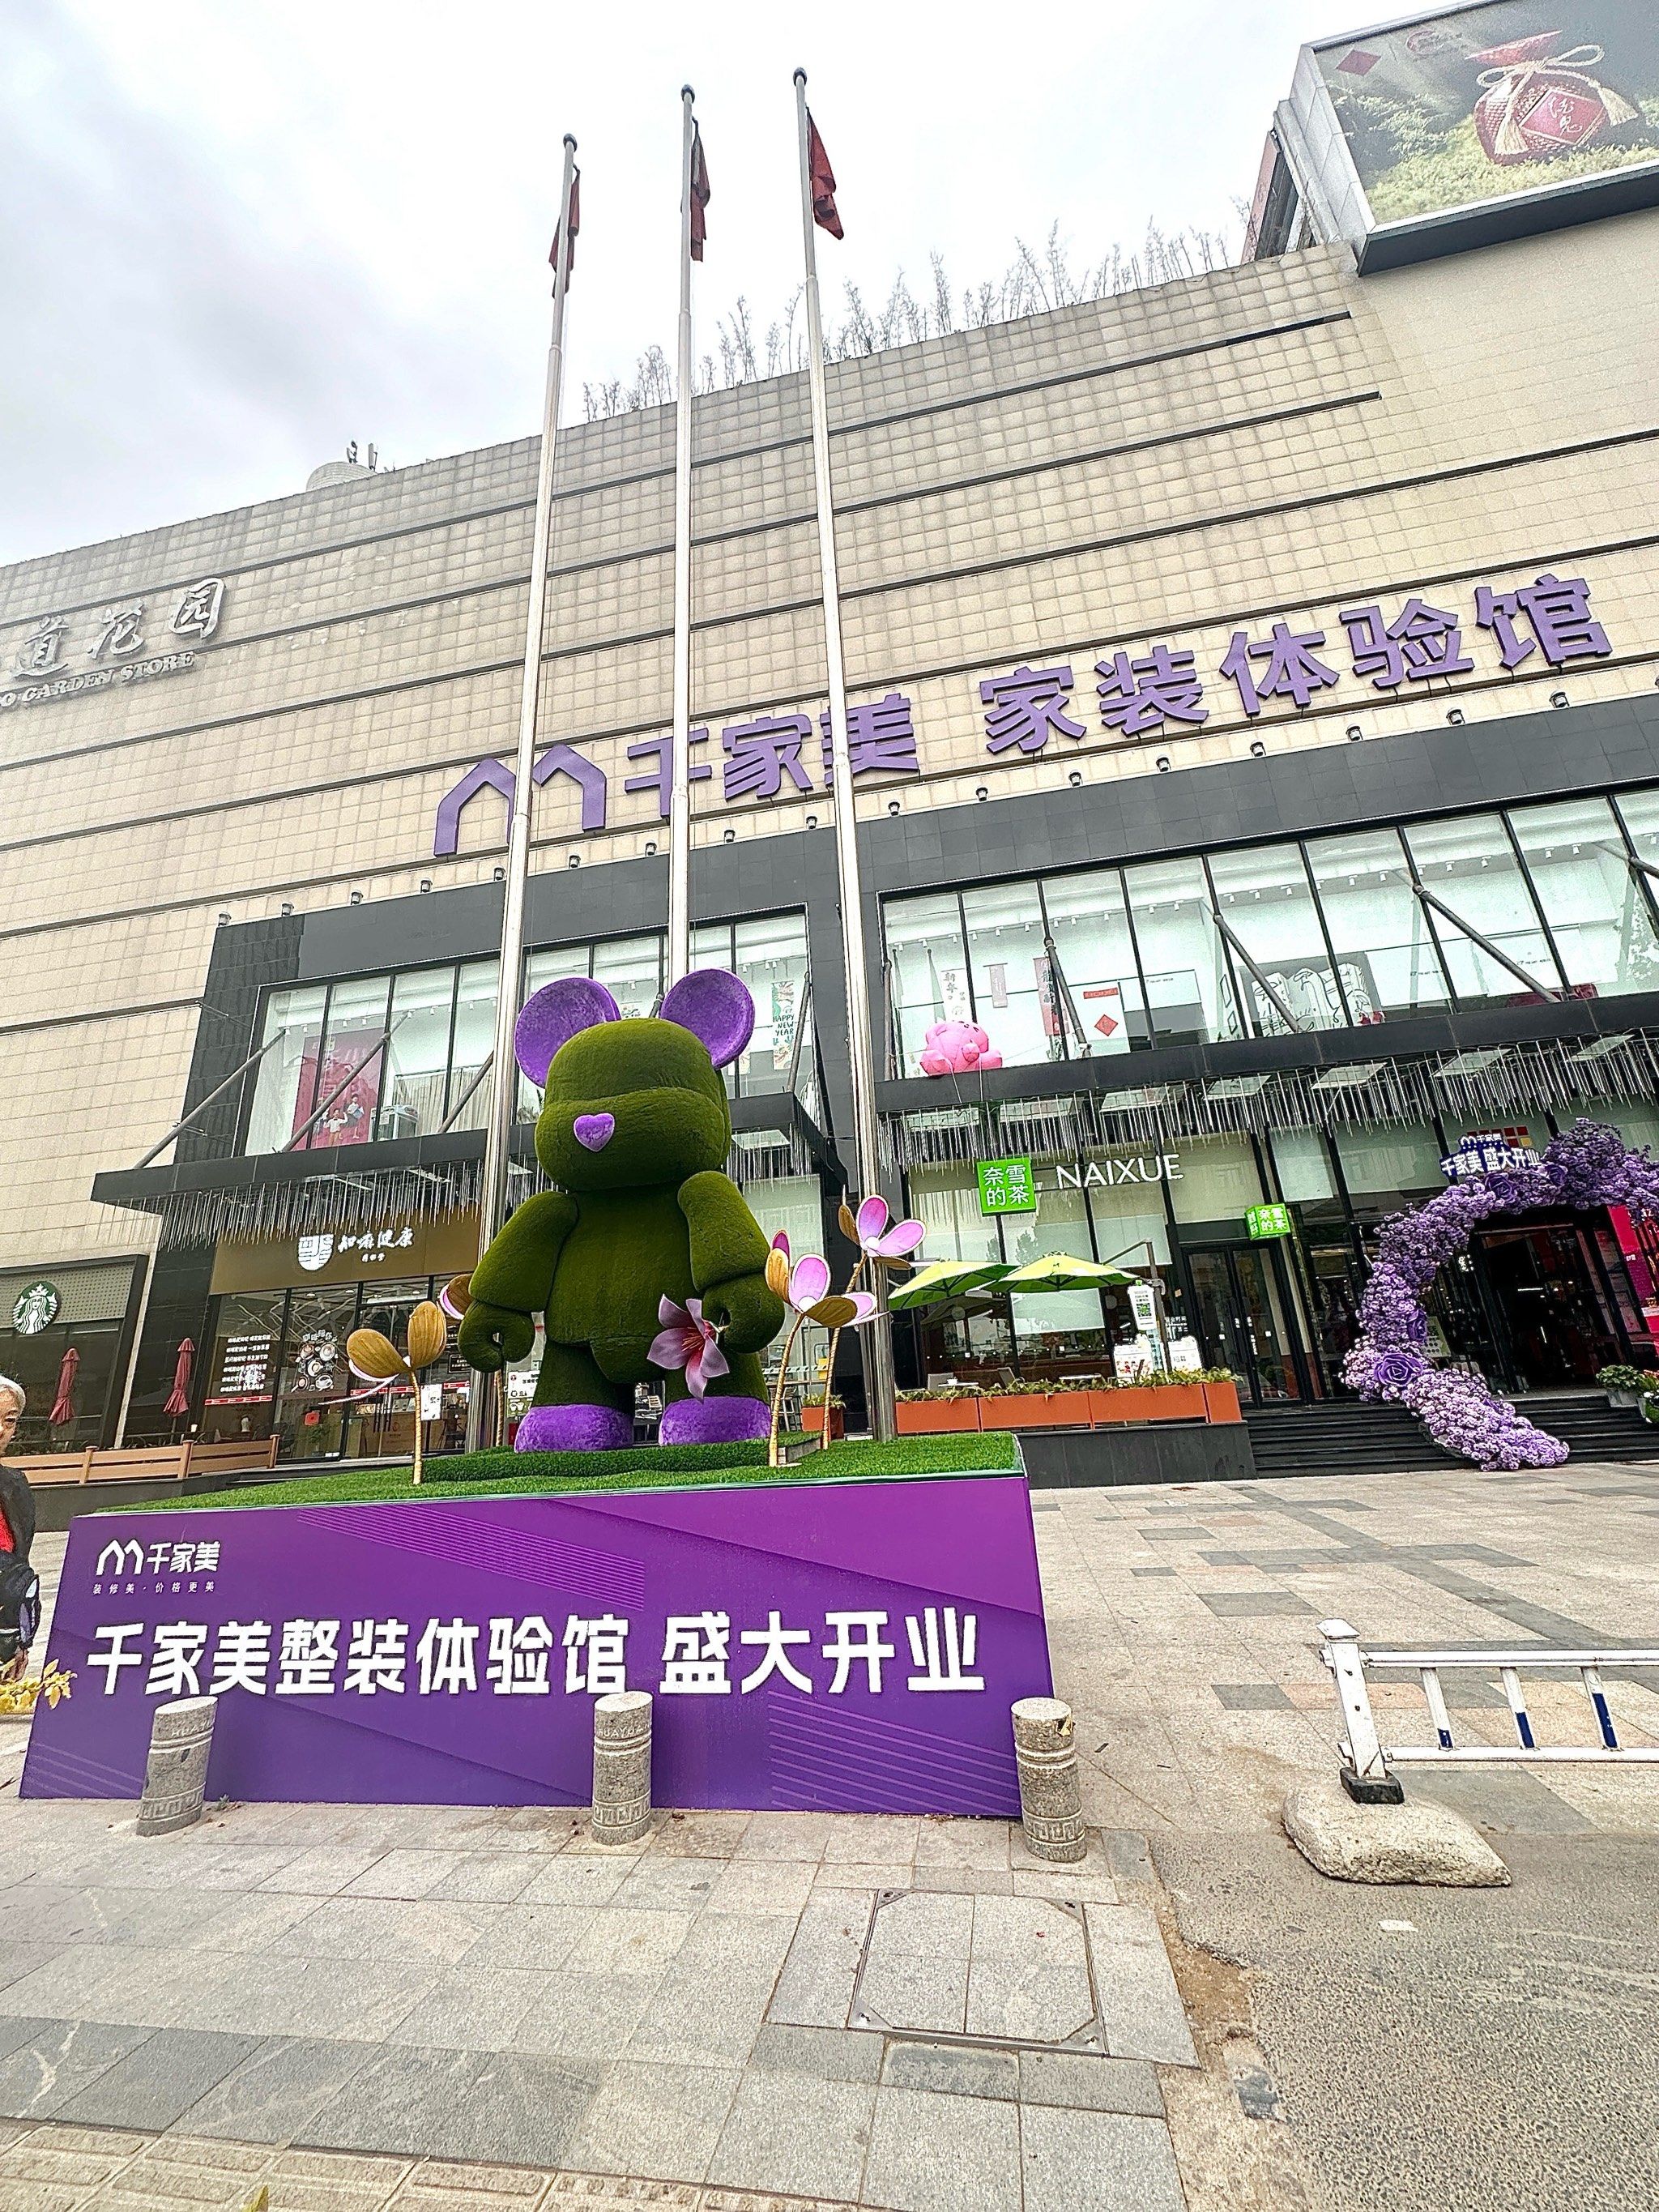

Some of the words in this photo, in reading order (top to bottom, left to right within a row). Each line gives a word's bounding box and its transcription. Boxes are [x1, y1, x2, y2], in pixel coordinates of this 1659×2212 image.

[22, 669, 114, 702] GARDEN
[121, 651, 195, 683] STORE
[625, 693, 919, 819] 千家美
[978, 573, 1614, 754] 家装体验馆
[773, 1014, 795, 1023] HAPPY
[775, 1028, 795, 1036] YEAR
[983, 1164, 1026, 1186] 奈雪
[1056, 1154, 1184, 1189] NAIXUE
[1440, 1149, 1485, 1176] 千家美
[1482, 1146, 1542, 1172] 盛大开业
[986, 1185, 1030, 1206] 的茶
[147, 1540, 220, 1574] 千家美
[86, 1613, 630, 1695] 千家美整装体验馆
[658, 1607, 986, 1695] 盛大开业
